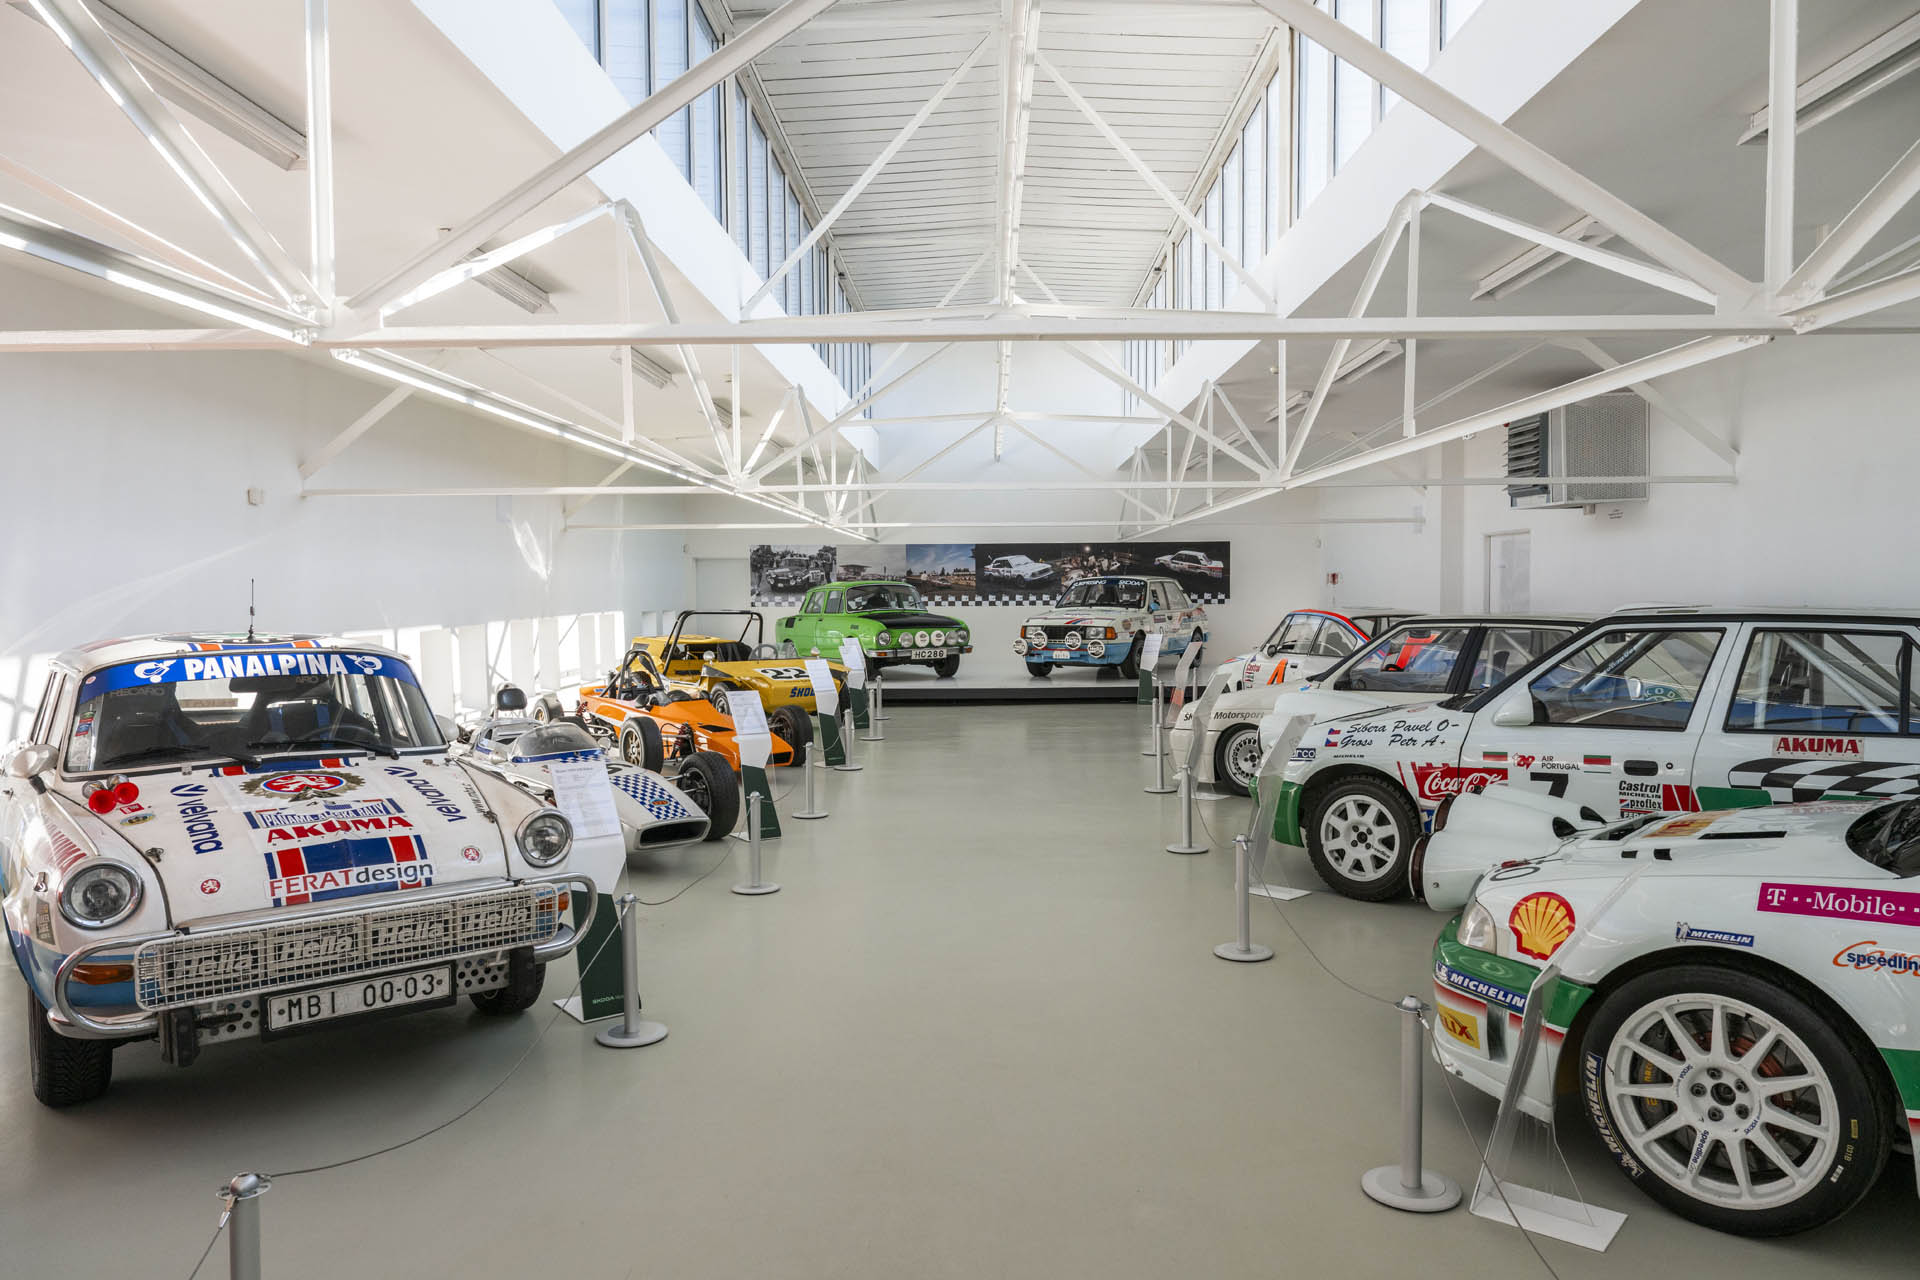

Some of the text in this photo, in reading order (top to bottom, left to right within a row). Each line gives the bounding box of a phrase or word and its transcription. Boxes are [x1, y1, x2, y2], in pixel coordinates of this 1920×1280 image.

[184, 653, 348, 681] PANALPINA
[761, 668, 809, 680] 22
[1214, 711, 1264, 721] Motorsport
[1391, 720, 1431, 733] Pavel
[1340, 735, 1374, 748] Gross
[1388, 734, 1418, 747] Petr
[1776, 737, 1860, 753] AKUMA
[1530, 772, 1568, 799] 7
[1619, 781, 1660, 794] Castrol
[1619, 791, 1661, 799] MICHELIN
[405, 779, 467, 822] velvana
[1630, 799, 1662, 809] proflex
[177, 799, 224, 855] velvana
[267, 816, 414, 844] AKUMA
[462, 905, 529, 931] Hella
[376, 921, 445, 947] Hella
[1690, 931, 1752, 944] MICHELIN
[274, 935, 353, 962] Hella
[1846, 952, 1920, 971] speedlin
[173, 951, 254, 978] Hella
[363, 974, 435, 1007] 00-03
[1450, 972, 1527, 1009] MICHELIN
